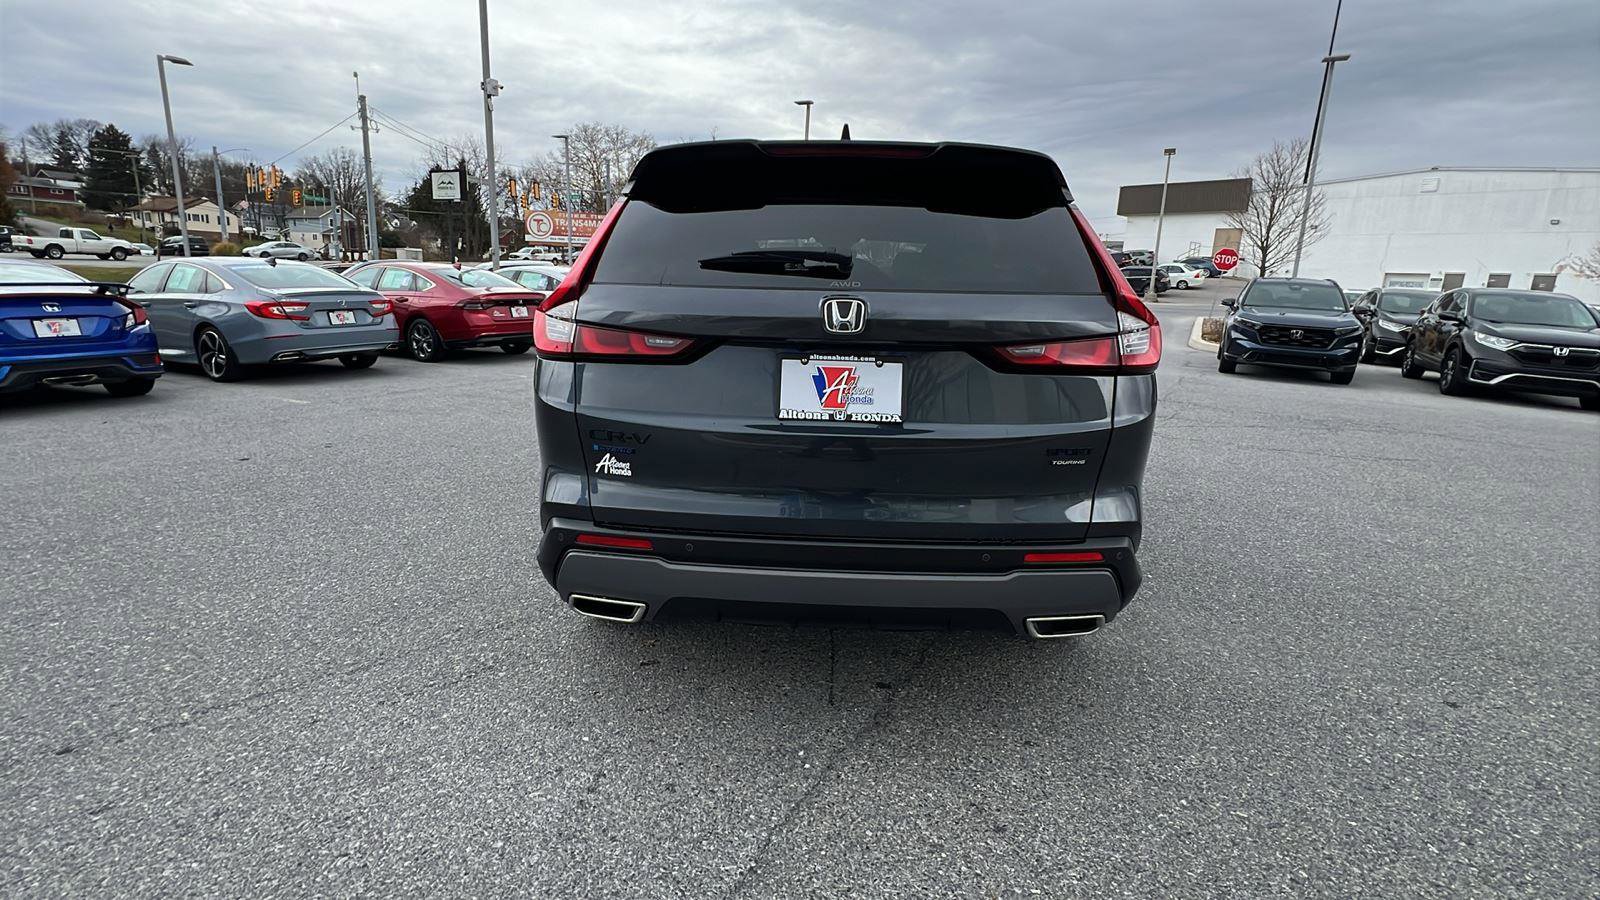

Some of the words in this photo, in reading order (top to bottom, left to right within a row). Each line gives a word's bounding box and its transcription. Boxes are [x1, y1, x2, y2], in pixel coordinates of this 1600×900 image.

[1215, 255, 1237, 265] STOP
[830, 280, 862, 288] AWD
[809, 353, 876, 362] altoonahonda.com
[841, 394, 874, 405] Honda
[779, 408, 830, 420] Altoona
[851, 412, 902, 423] HONDA
[589, 429, 652, 445] CR-V
[609, 468, 632, 477] Honda
